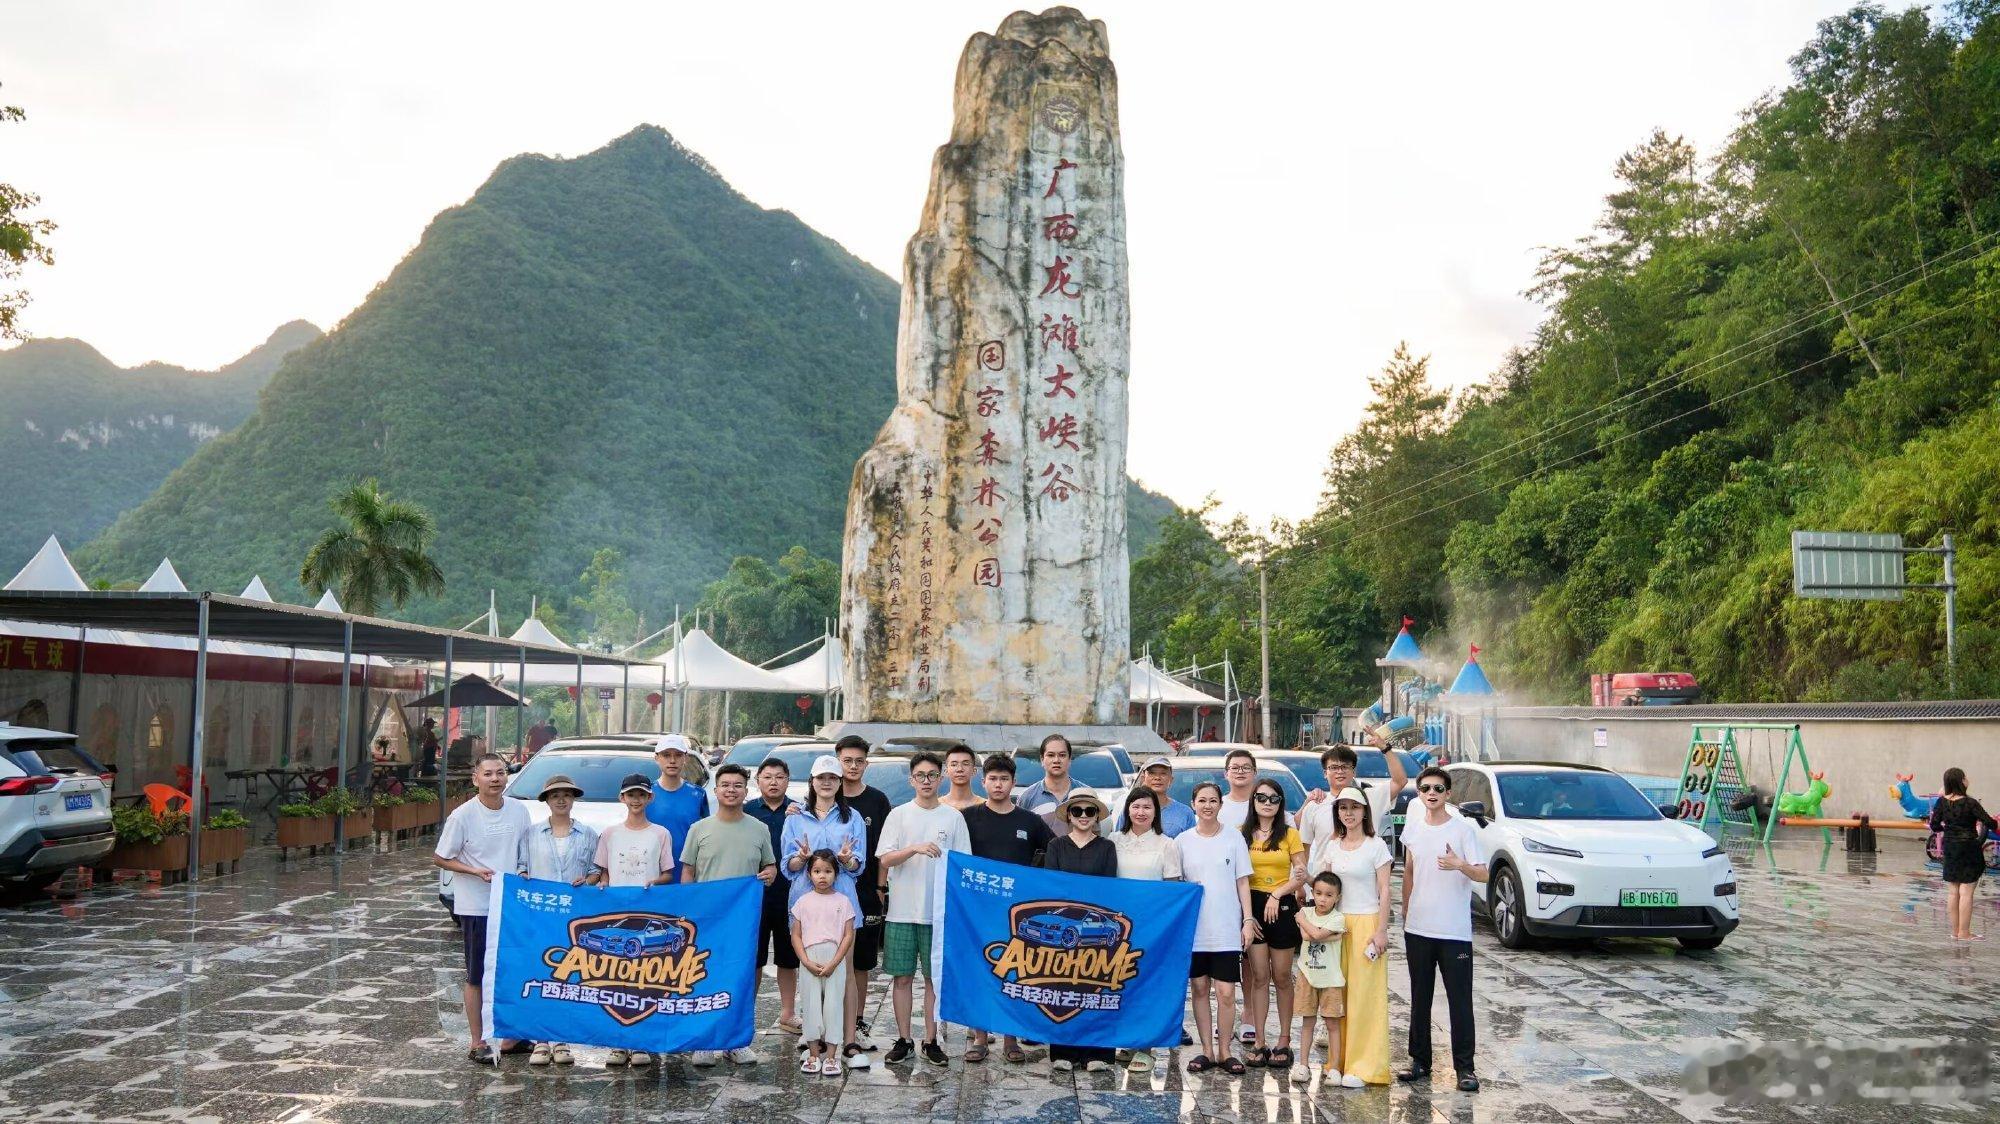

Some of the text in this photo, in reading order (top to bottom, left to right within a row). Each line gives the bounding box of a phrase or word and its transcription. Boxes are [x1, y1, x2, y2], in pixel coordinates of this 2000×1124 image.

[1038, 158, 1082, 502] 广西龙滩大峡谷
[971, 340, 1005, 588] 国家森林公园
[517, 888, 573, 907] 汽车之家
[962, 868, 1015, 890] 汽车之家
[543, 945, 711, 994] AUTOHOME
[984, 938, 1142, 990] AUTOHOME
[1002, 981, 1121, 1010] 年轻就去深蓝
